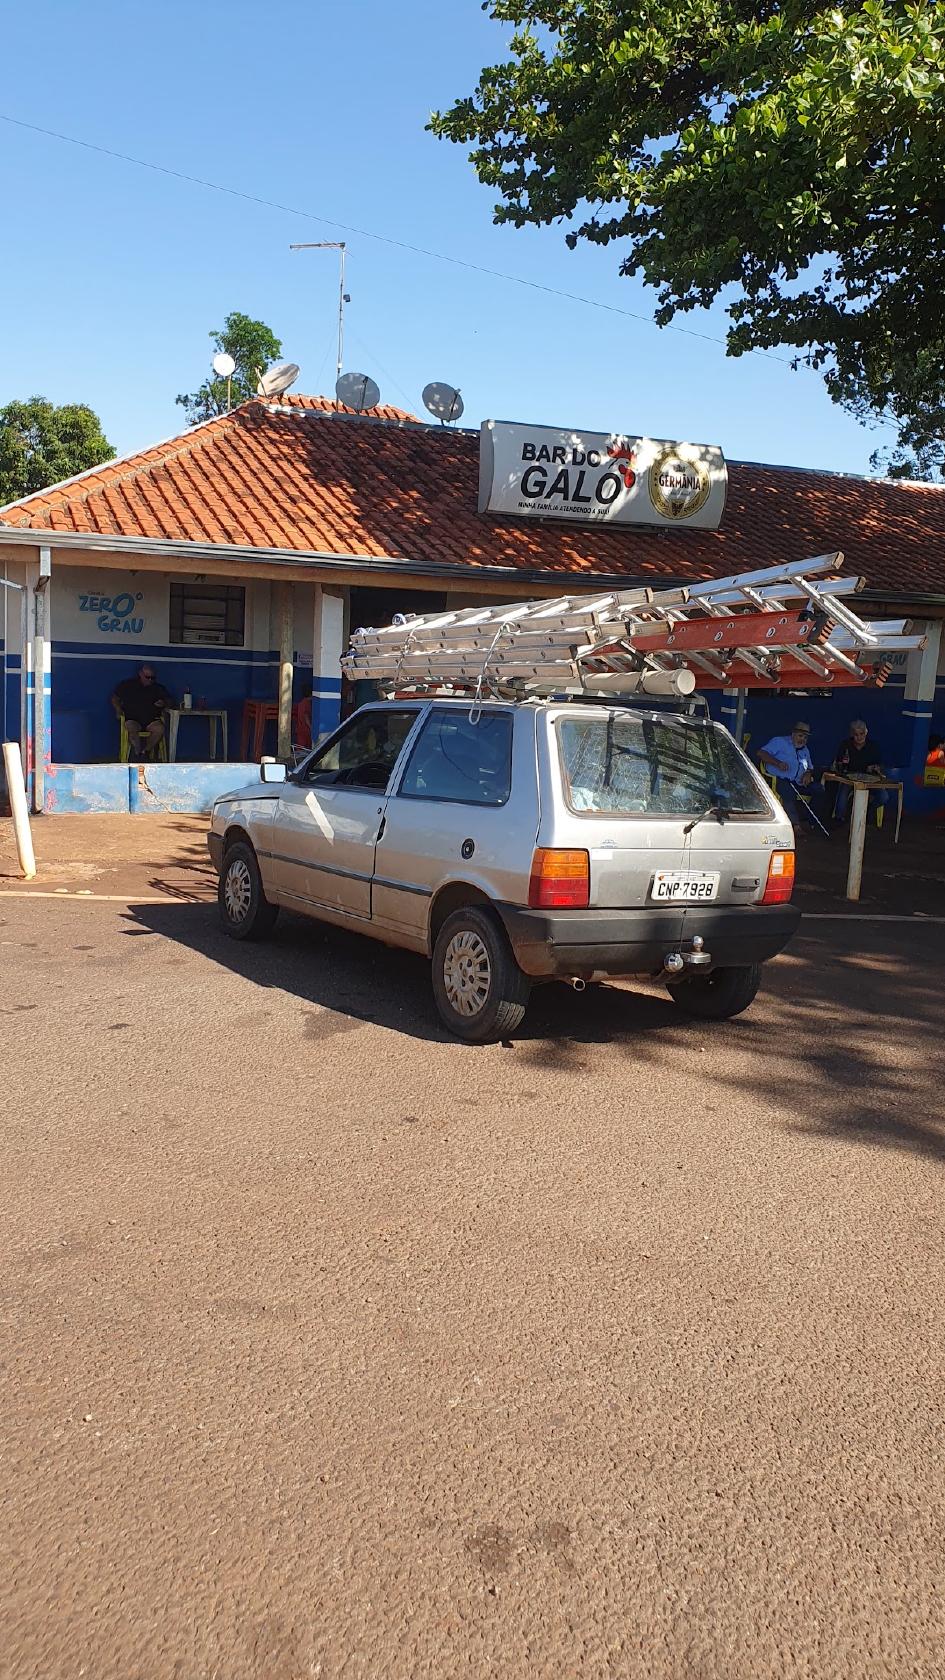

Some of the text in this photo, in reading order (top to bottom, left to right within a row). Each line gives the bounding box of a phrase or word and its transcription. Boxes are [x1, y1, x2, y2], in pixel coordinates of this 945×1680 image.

[521, 443, 601, 468] BAR DO
[520, 465, 622, 505] GALO
[658, 473, 701, 490] GERMÂNIA
[518, 501, 536, 510] MINHA
[559, 505, 592, 514] ATENDENDO
[97, 615, 144, 633] GRAU
